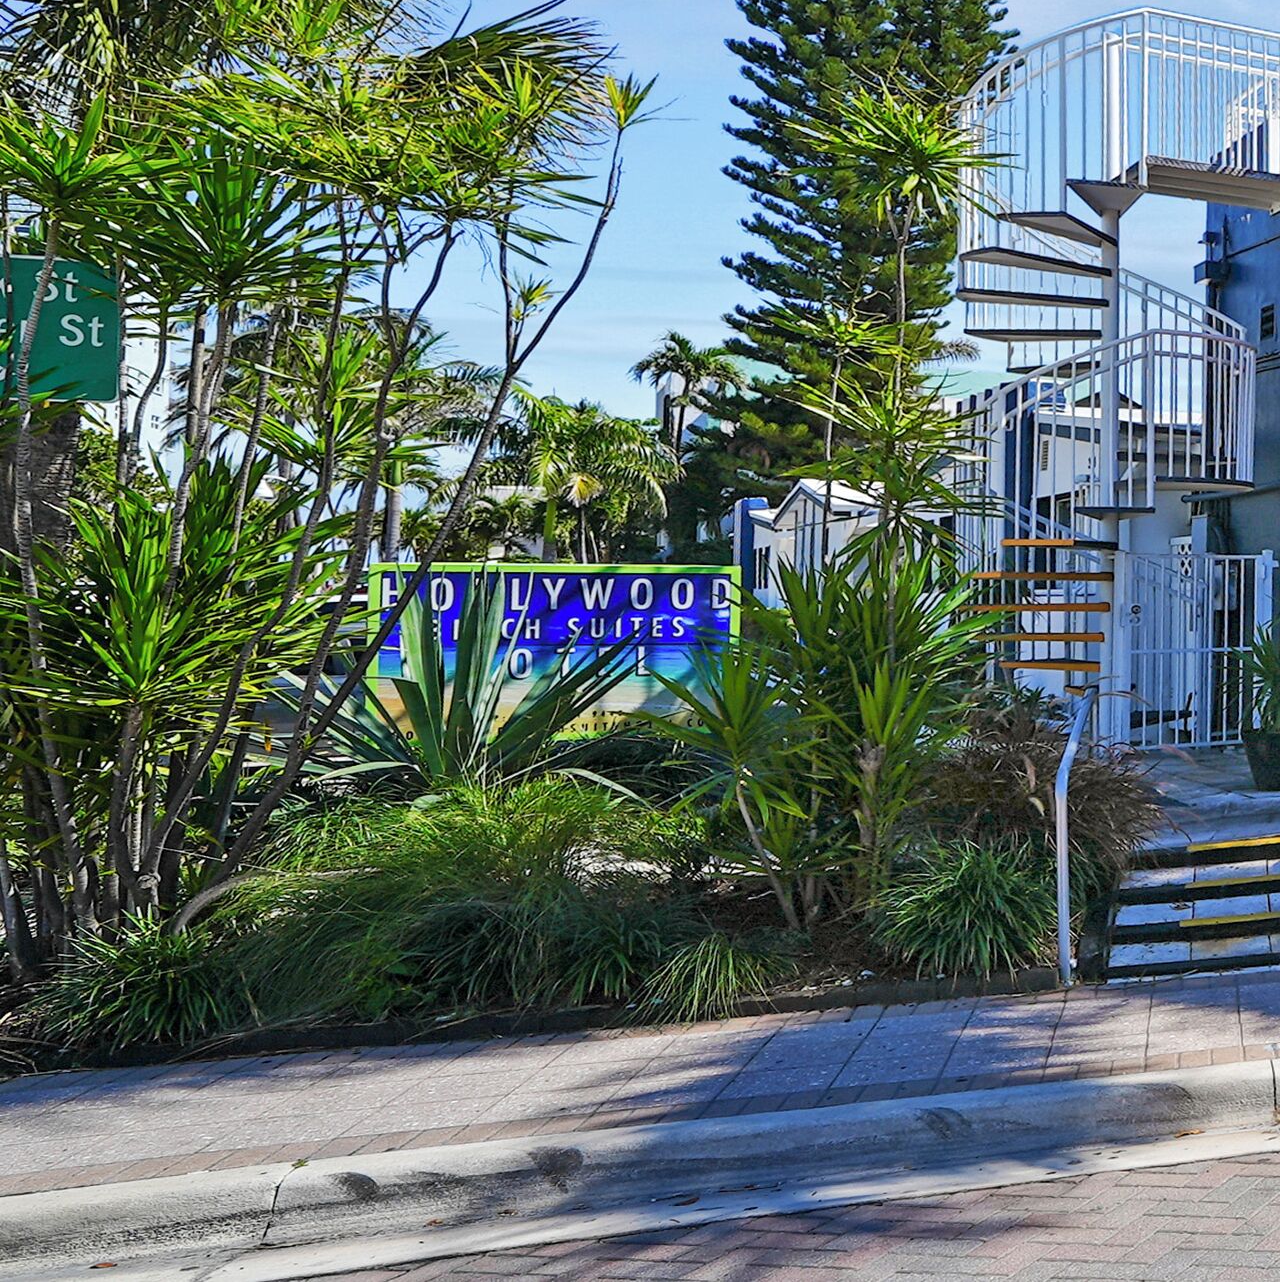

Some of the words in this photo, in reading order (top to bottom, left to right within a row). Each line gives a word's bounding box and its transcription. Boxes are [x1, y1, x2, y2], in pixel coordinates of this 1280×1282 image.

[33, 270, 78, 302] St
[59, 314, 104, 347] St
[382, 578, 731, 611] HOLYWOOD
[567, 617, 685, 638] SUITES
